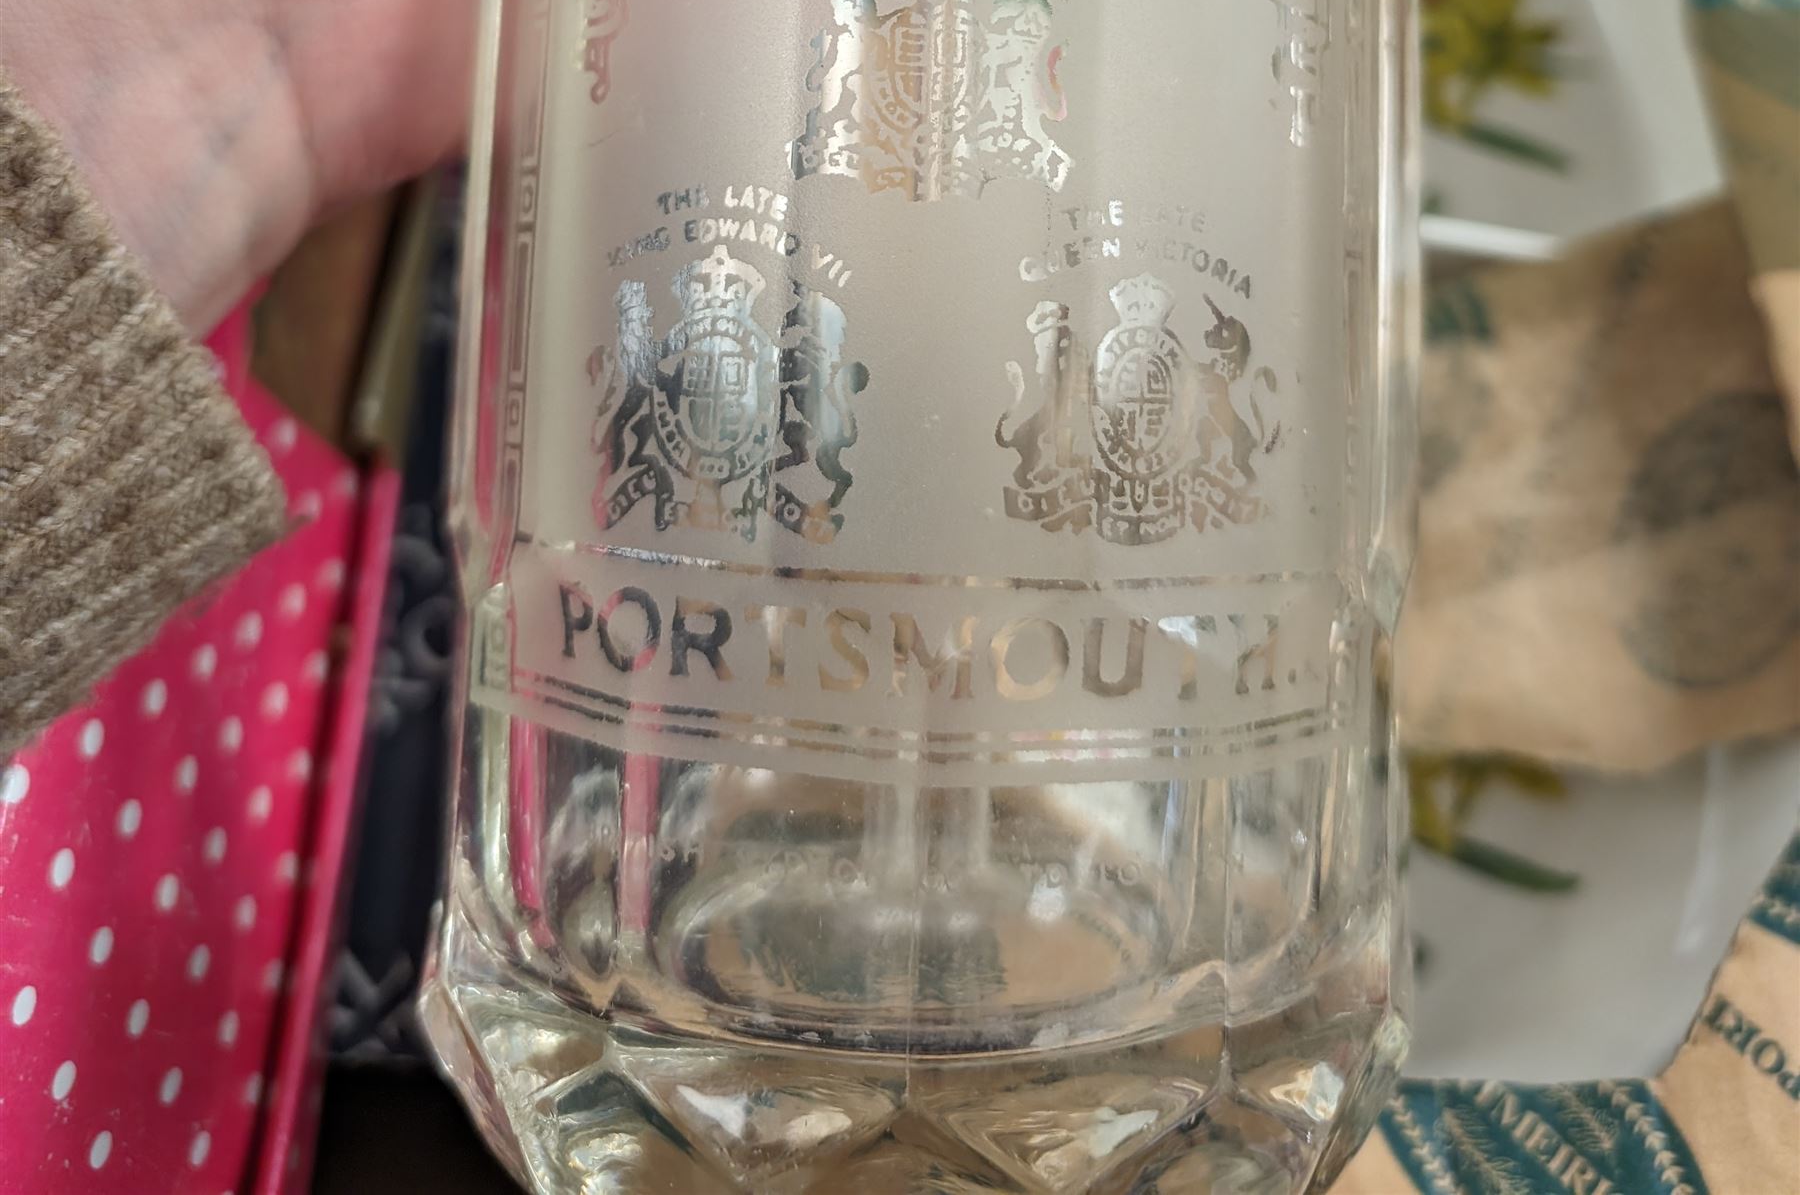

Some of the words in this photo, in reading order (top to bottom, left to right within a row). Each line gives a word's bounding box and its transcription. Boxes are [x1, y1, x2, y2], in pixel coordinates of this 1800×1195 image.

[656, 188, 710, 215] THE
[724, 184, 788, 222] LATE
[684, 217, 800, 255] EDWARD
[811, 244, 853, 288] VII
